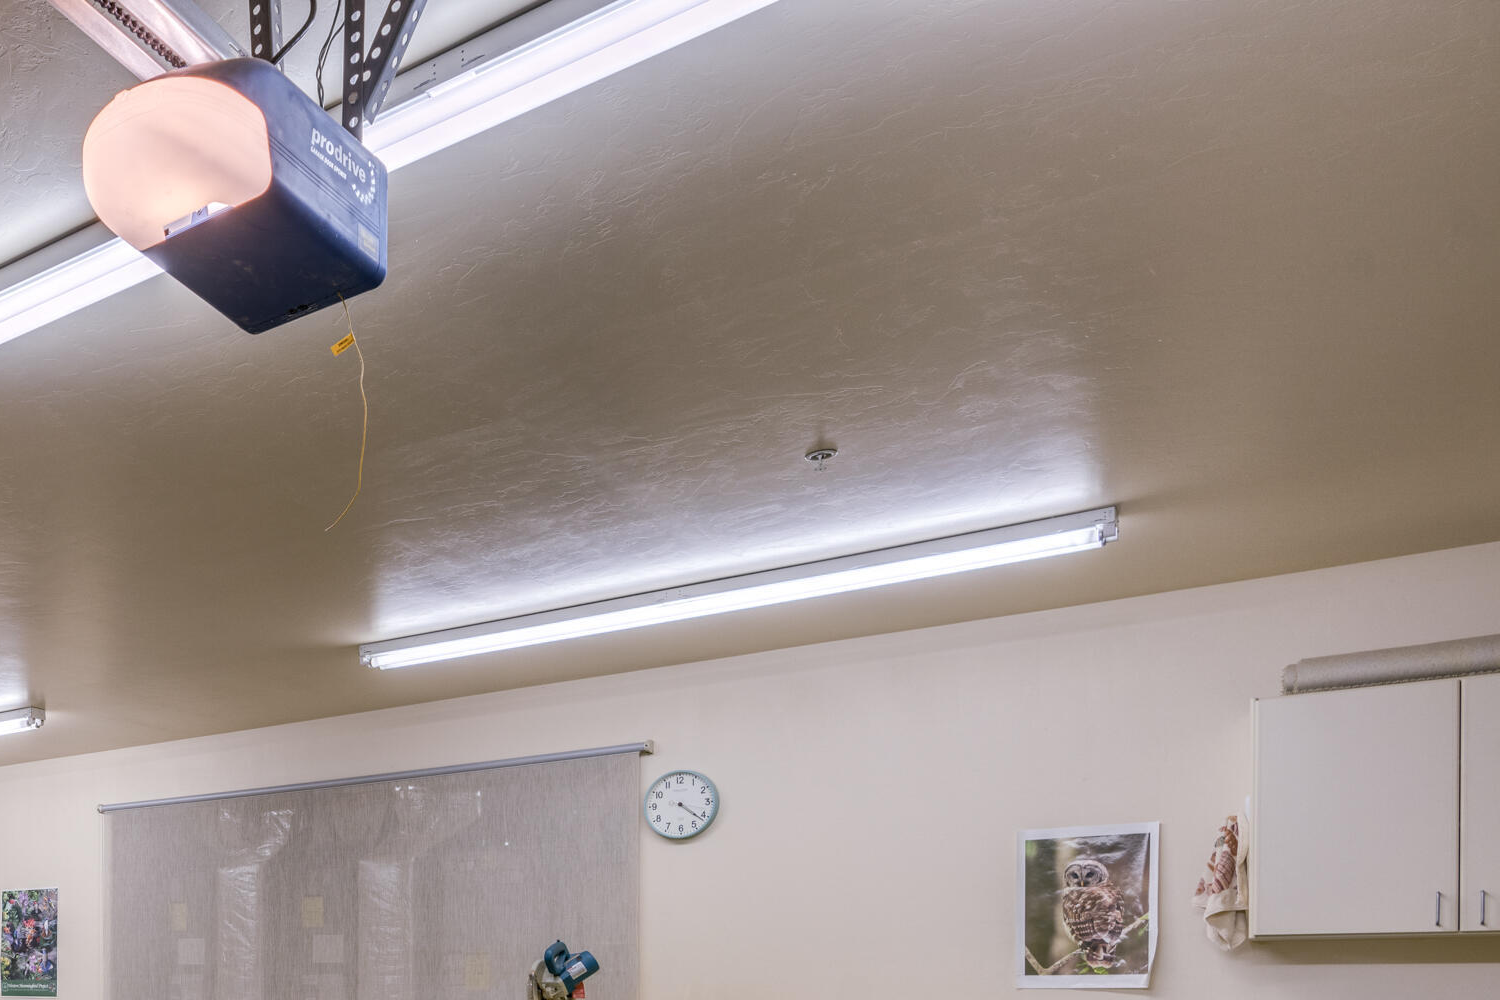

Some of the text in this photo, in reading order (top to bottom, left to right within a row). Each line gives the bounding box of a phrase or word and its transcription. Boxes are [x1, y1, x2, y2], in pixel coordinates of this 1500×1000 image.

[310, 128, 366, 183] prodrive
[676, 776, 684, 784] 12
[665, 781, 671, 789] 11
[700, 786, 706, 794] 2
[655, 791, 663, 799] 10
[705, 798, 711, 806] 3
[652, 803, 657, 811] 9
[701, 810, 707, 818] 4
[656, 814, 661, 823] 8
[666, 821, 671, 830] 7
[678, 824, 684, 832] 6
[691, 820, 697, 828] 5
